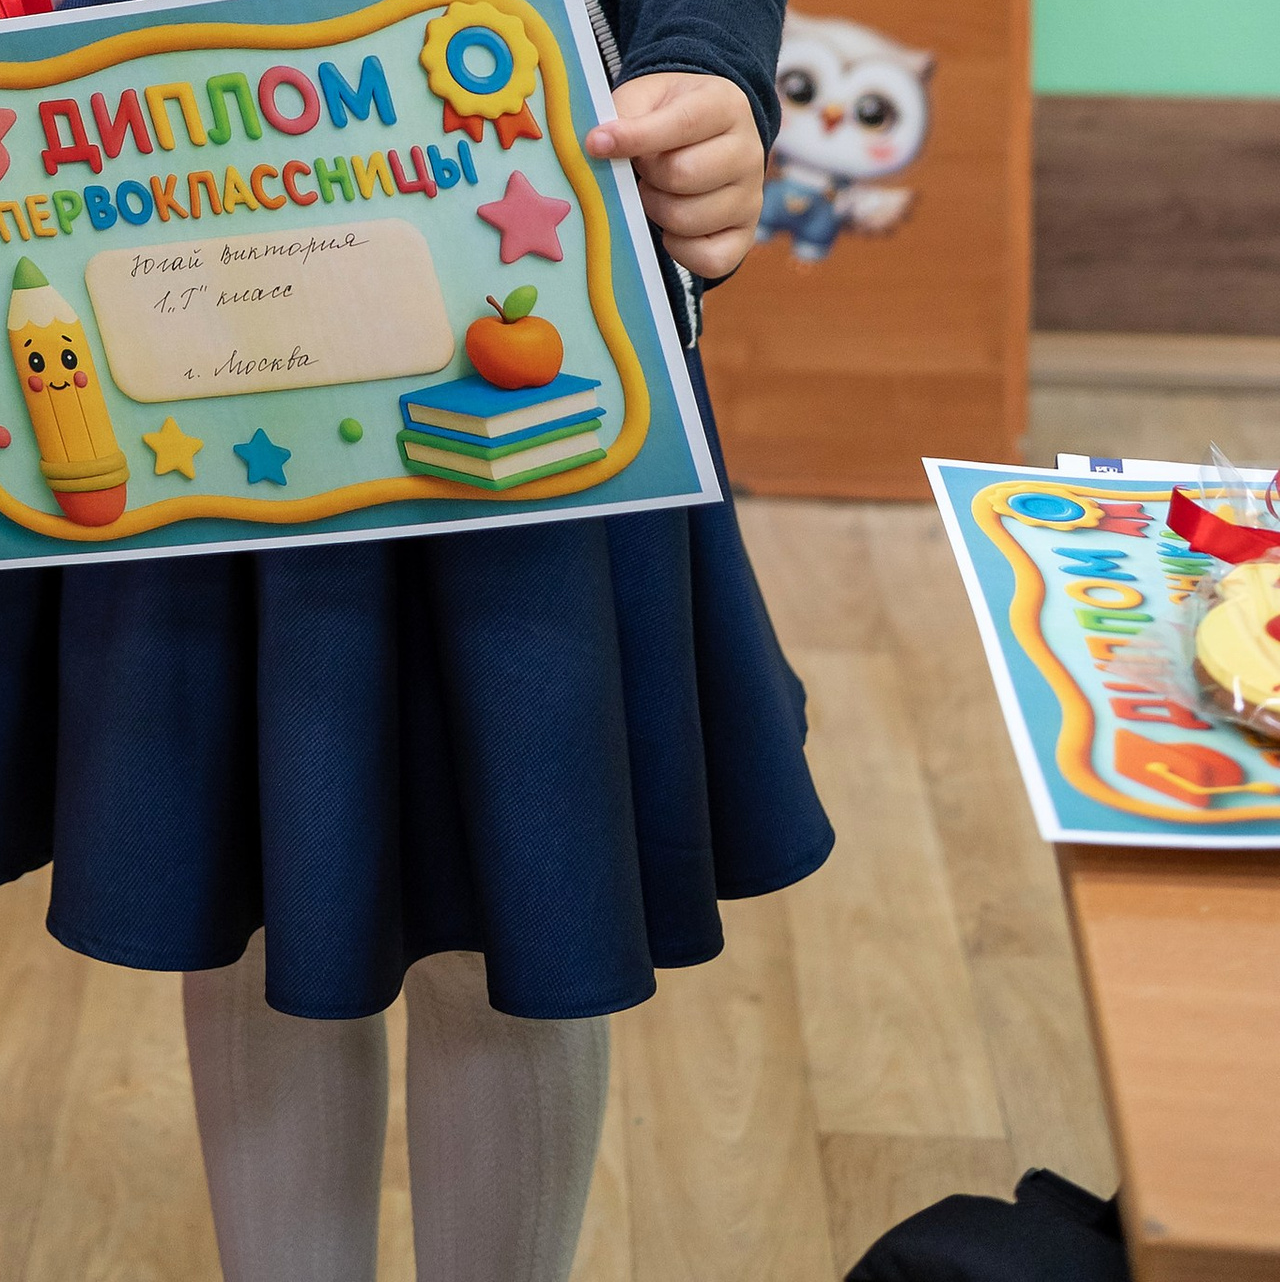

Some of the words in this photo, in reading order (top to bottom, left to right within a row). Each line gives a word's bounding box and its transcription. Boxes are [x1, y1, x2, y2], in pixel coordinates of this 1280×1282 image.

[37, 54, 397, 177] ДИПЛОМ
[130, 248, 205, 278] Югай
[219, 231, 370, 266] Виктория
[215, 283, 295, 308] класс
[183, 366, 202, 381] г.
[213, 345, 320, 378] Москва
